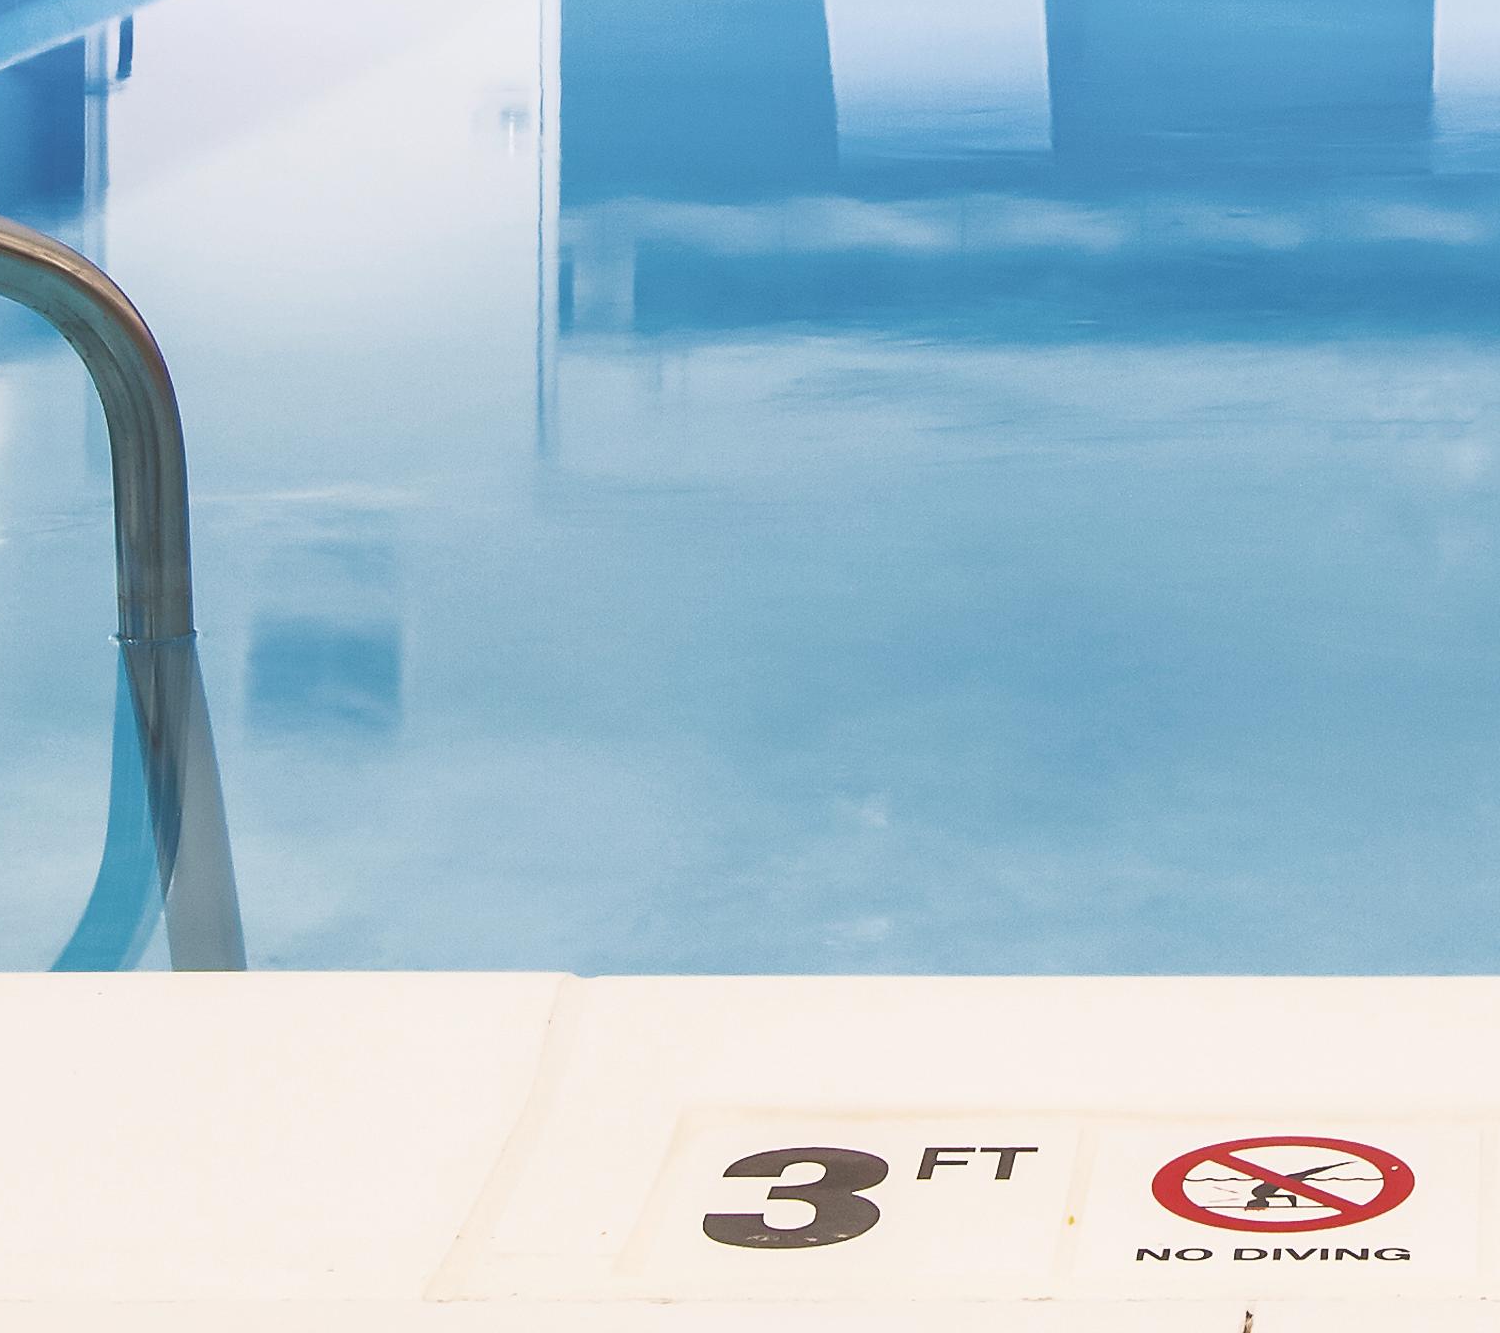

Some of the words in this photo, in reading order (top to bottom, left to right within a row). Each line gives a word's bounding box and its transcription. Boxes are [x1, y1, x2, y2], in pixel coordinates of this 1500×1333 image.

[702, 1146, 890, 1249] 3
[915, 1146, 1039, 1180] FT
[1135, 1247, 1214, 1262] NO
[1233, 1247, 1412, 1262] DIVING
